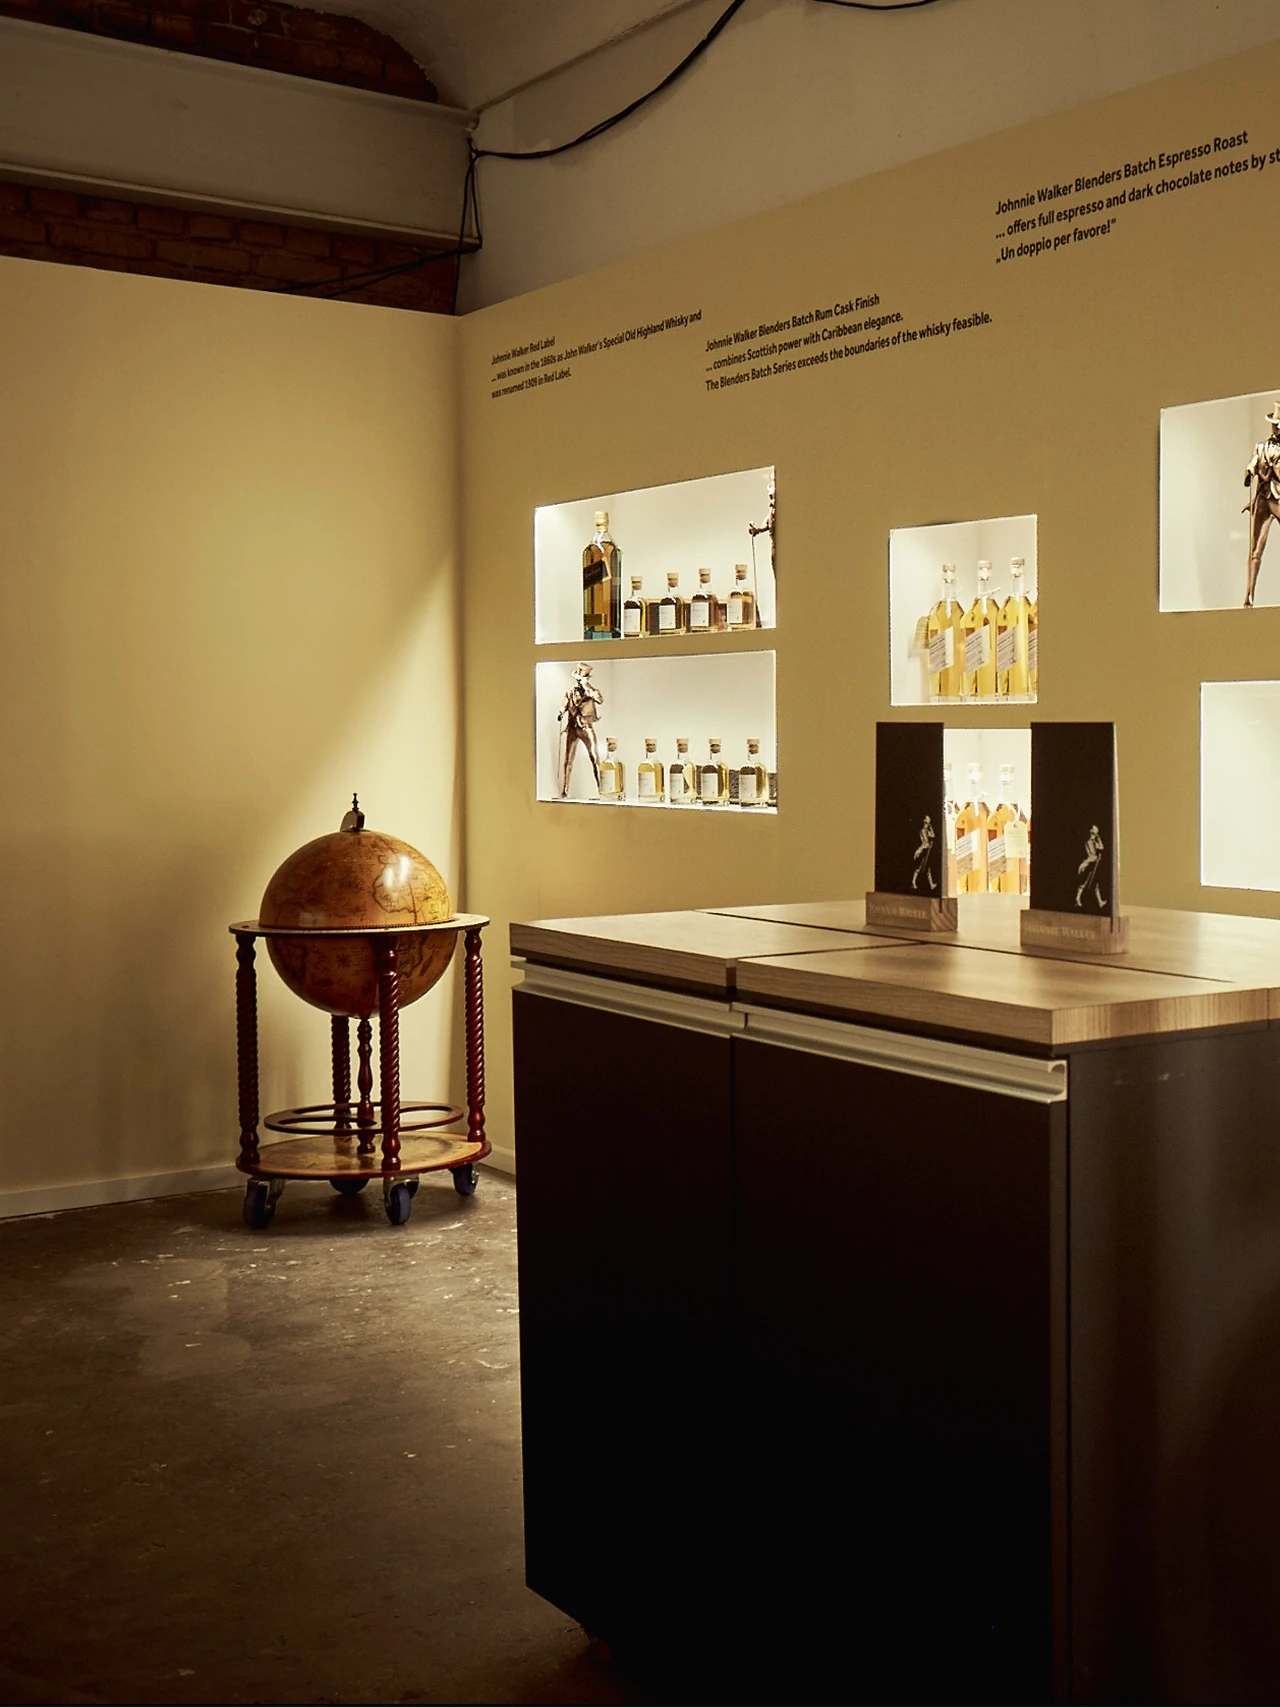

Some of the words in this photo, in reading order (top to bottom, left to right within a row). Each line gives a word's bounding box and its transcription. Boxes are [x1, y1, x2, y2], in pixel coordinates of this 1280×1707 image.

[996, 193, 1035, 215] Johnnie
[1037, 184, 1073, 203] Walker
[1075, 170, 1122, 192] Blenders
[1124, 157, 1156, 178] Batch
[1159, 144, 1211, 168] Espresso
[1214, 131, 1248, 152] Roast
[1007, 219, 1036, 235] offers
[1038, 210, 1054, 227] full
[1056, 200, 1104, 223] espresso
[1106, 190, 1126, 208] and
[1128, 183, 1153, 202] dark
[1156, 169, 1212, 195] chocolate
[1214, 159, 1248, 178] notes
[1251, 154, 1266, 171] by
[1017, 237, 1052, 257] doppio
[1054, 234, 1071, 251] per
[706, 335, 732, 352] Johnnie
[733, 329, 757, 344] Walker
[759, 320, 791, 337] Blenders
[792, 312, 814, 328] Batch
[815, 309, 833, 322] Rum
[834, 300, 854, 316] Cask
[855, 294, 880, 311] Finish
[706, 379, 719, 391] The
[720, 373, 750, 388] Blenders
[751, 365, 772, 380] Batch
[773, 360, 796, 374] Series
[797, 351, 829, 368] exceeds
[830, 348, 843, 361] the
[844, 336, 890, 357] boundaries
[891, 331, 901, 345] of
[902, 329, 918, 343] the
[919, 322, 951, 339] whisky
[952, 312, 992, 331] feasible.
[713, 353, 746, 369] combines
[747, 343, 777, 360] Scottish
[778, 338, 802, 355] power
[803, 331, 820, 345] with
[822, 323, 862, 341] Caribbean
[864, 313, 903, 330] elegance.
